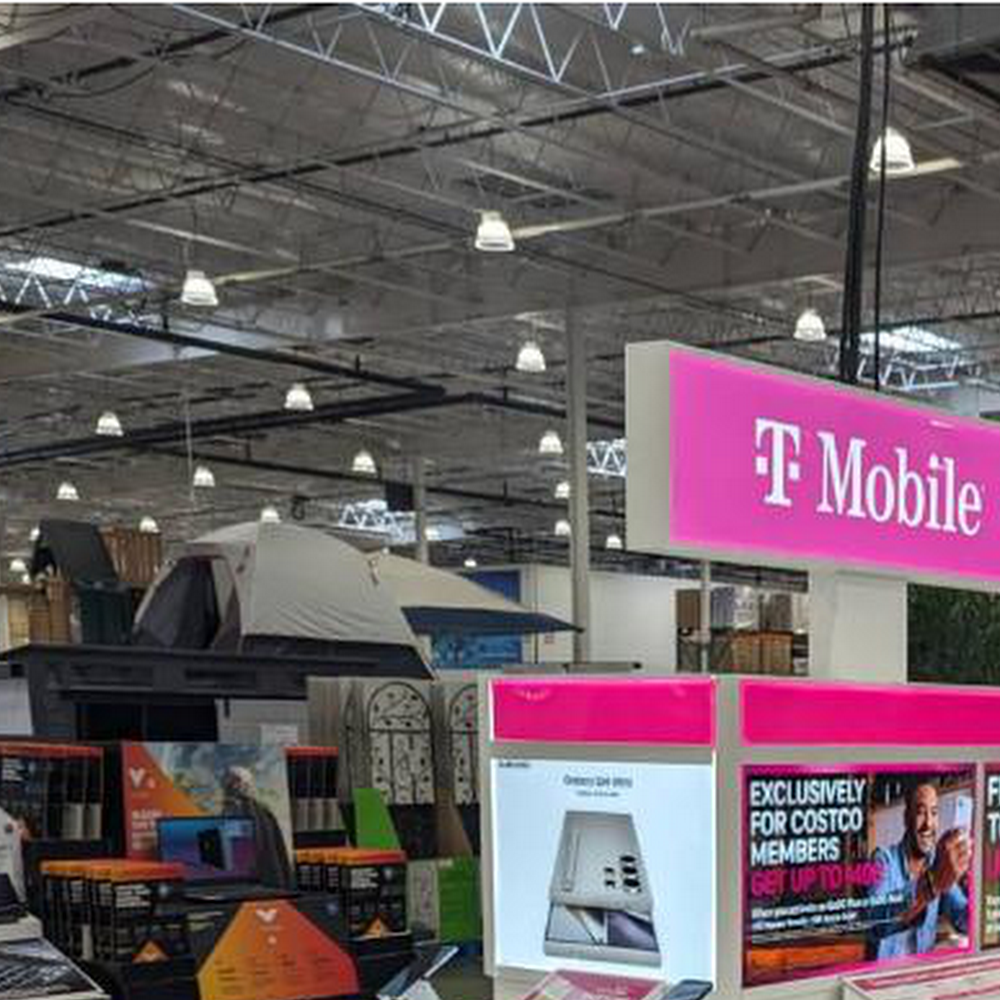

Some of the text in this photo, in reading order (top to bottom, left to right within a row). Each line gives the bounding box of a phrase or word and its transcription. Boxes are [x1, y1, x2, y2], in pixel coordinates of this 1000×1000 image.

[755, 417, 982, 536] T Mobile
[751, 778, 866, 806] EXCLUSIVELY
[751, 806, 864, 837] FOR COSTCO
[751, 837, 841, 867] MEMBERS
[792, 866, 816, 893] UP
